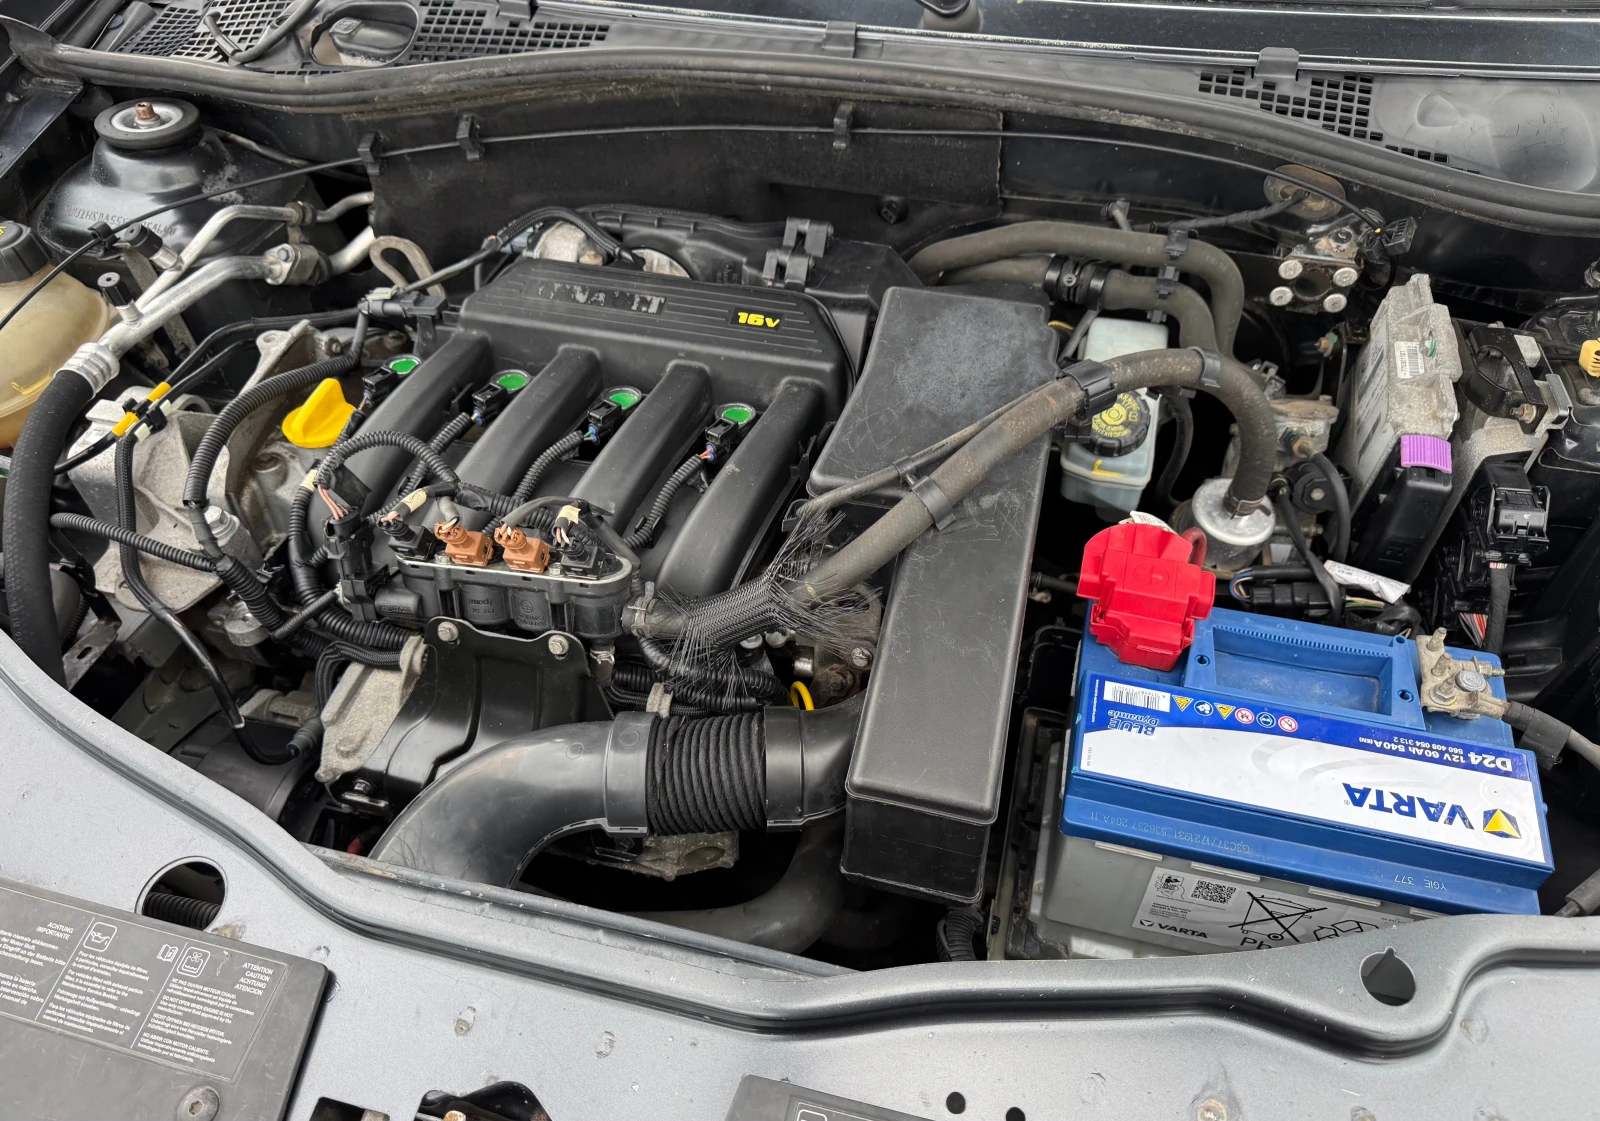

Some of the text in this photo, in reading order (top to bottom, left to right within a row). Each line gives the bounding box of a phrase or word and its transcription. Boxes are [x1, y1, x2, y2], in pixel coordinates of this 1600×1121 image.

[1106, 708, 1159, 726] Dynamic
[1107, 717, 1156, 736] BLUE
[1400, 737, 1413, 745] 313
[1415, 740, 1430, 748] 054
[1448, 746, 1463, 754] 560
[1443, 753, 1465, 763] 12V
[1468, 752, 1512, 771] D24
[1342, 783, 1475, 830] VARTA
[1393, 872, 1414, 885] 377
[36, 926, 70, 939] IMPORTANTE
[47, 922, 73, 933] ACHTUNG
[1156, 922, 1209, 940] VARTA
[242, 962, 273, 974] ATTENTION
[245, 970, 270, 981] CAUTION
[239, 977, 266, 988] ACHTUNG
[234, 984, 263, 995] ATENCION
